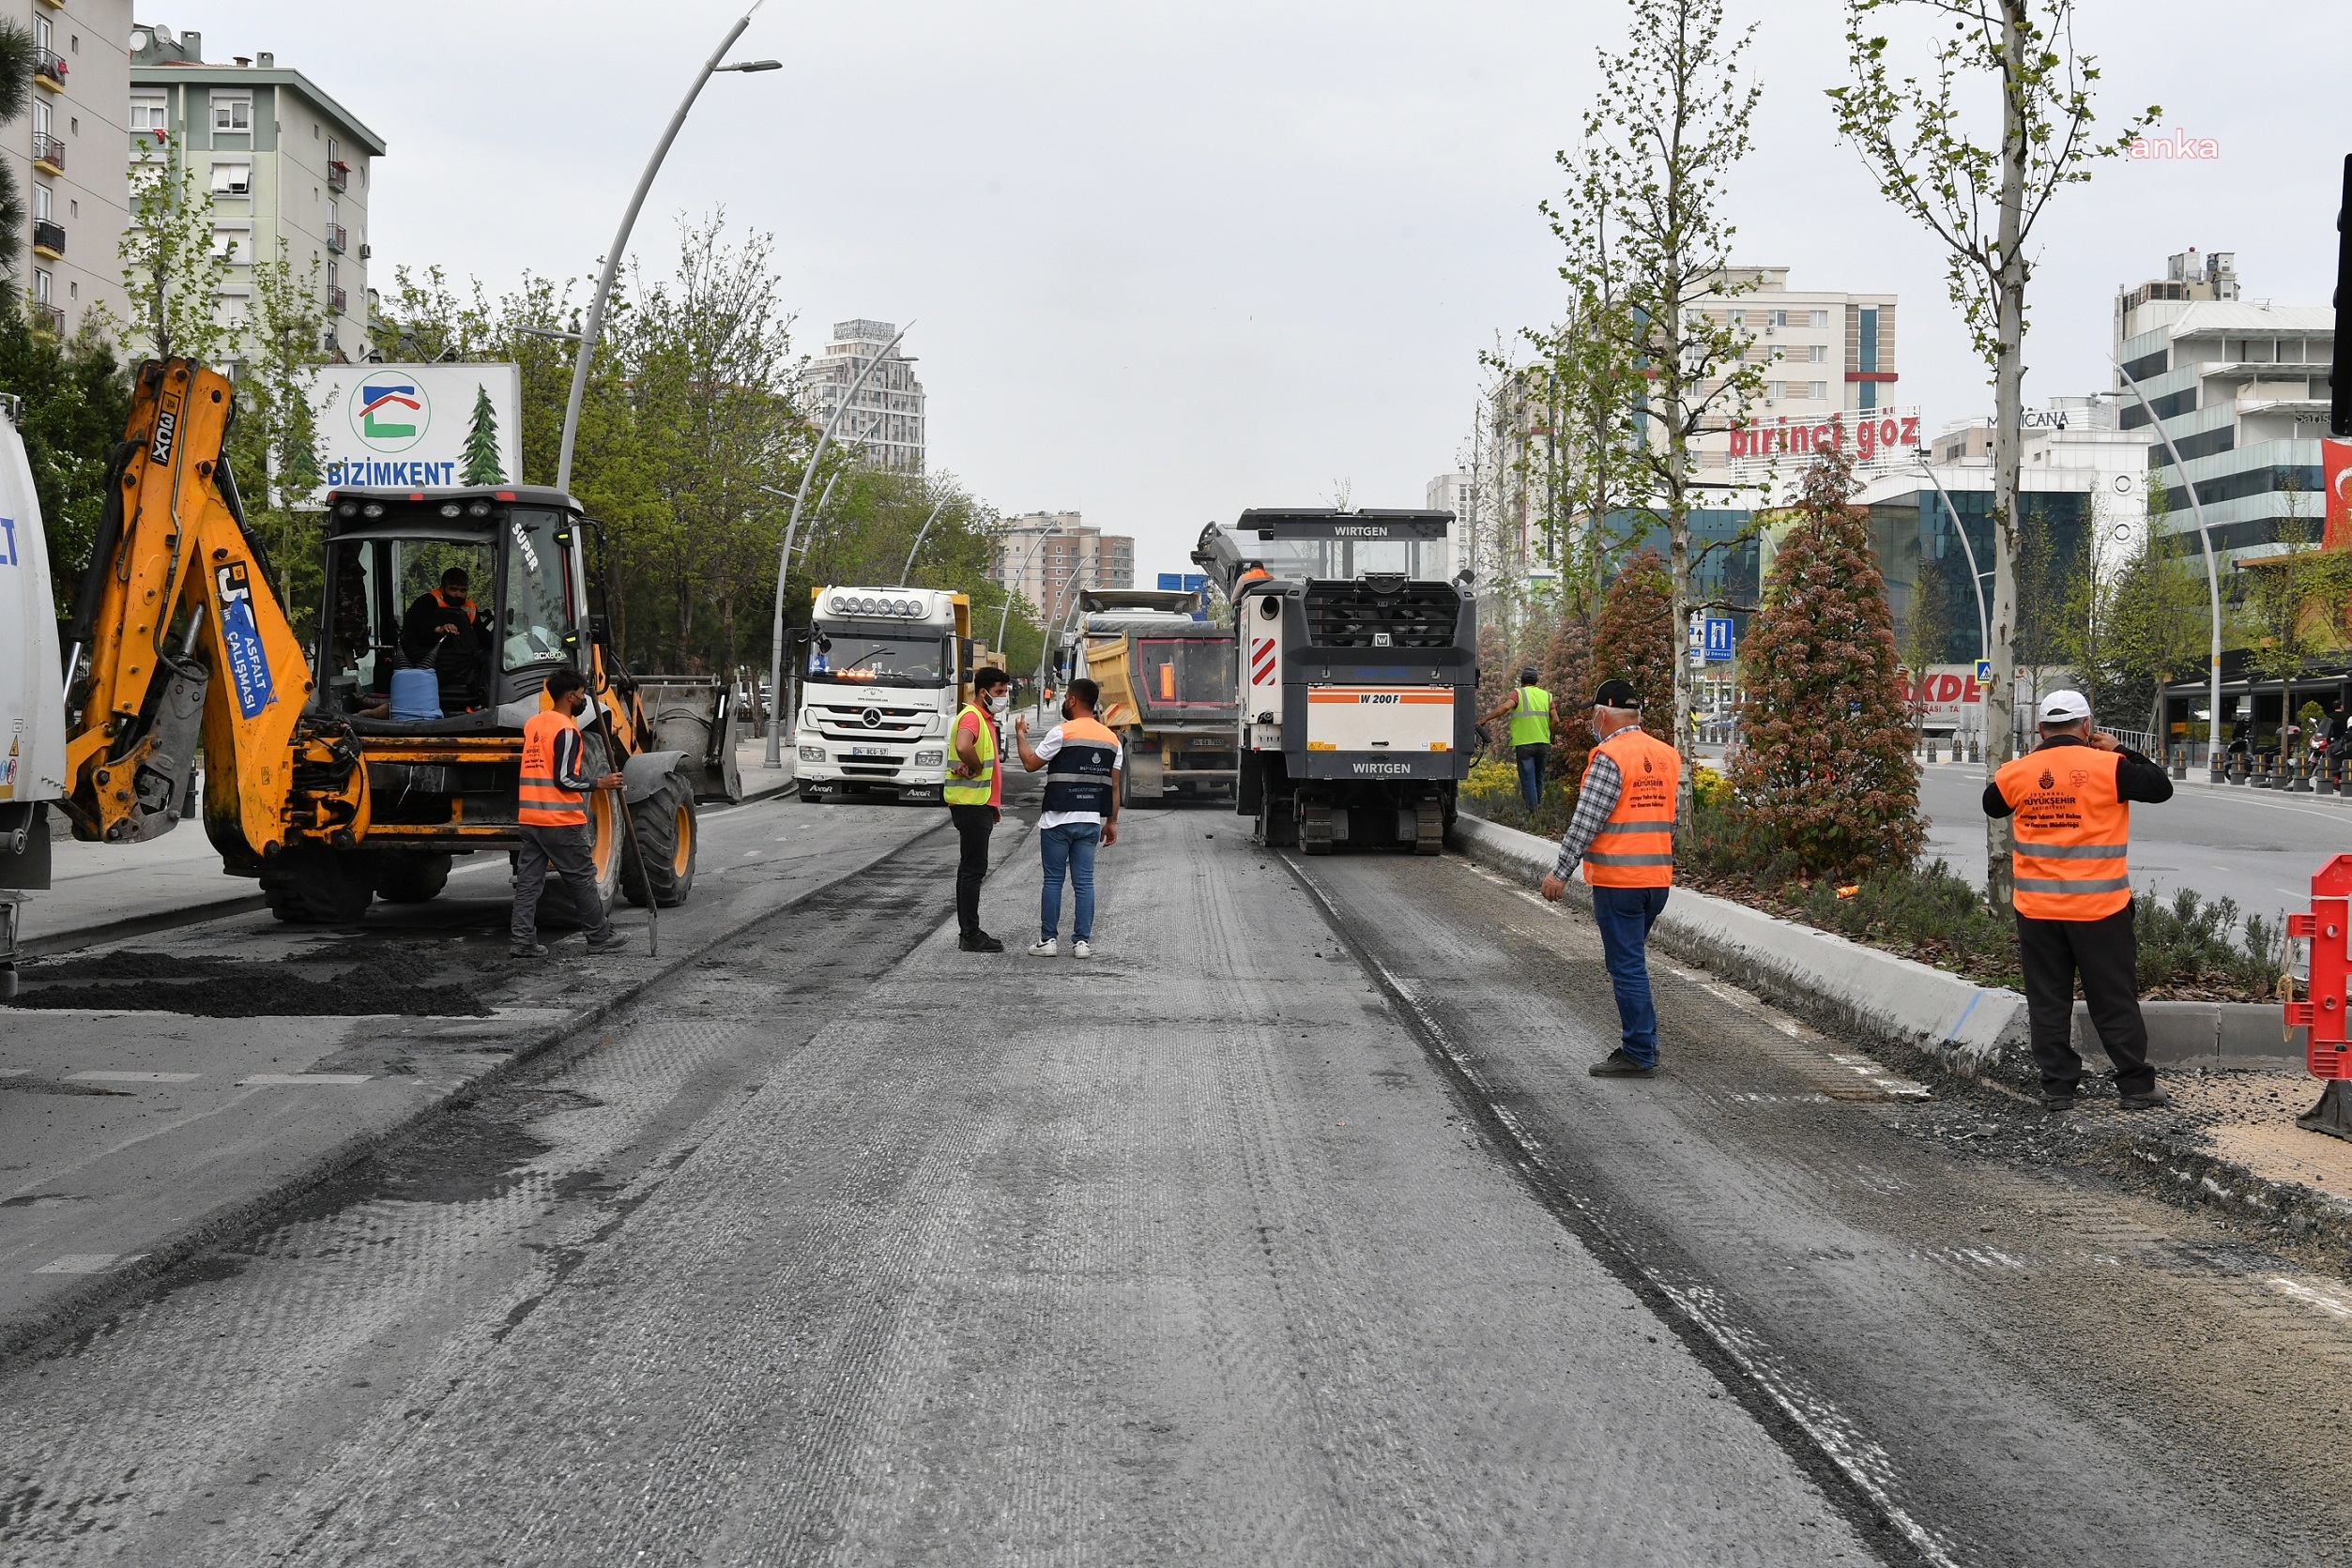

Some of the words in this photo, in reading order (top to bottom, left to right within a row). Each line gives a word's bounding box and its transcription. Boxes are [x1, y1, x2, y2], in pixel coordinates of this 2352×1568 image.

[152, 412, 175, 460] 3CX
[1730, 412, 1840, 458] birinci
[1856, 406, 1919, 460] göz
[1987, 411, 2069, 429] MICANA
[328, 456, 454, 486] BİZİMKENT
[512, 523, 539, 571] SUPER
[1334, 526, 1388, 537] WIRTGEN
[226, 631, 256, 709] ÇALIŞMASI
[244, 637, 267, 689] ASFALT
[1352, 763, 1411, 774] WIRTGEN
